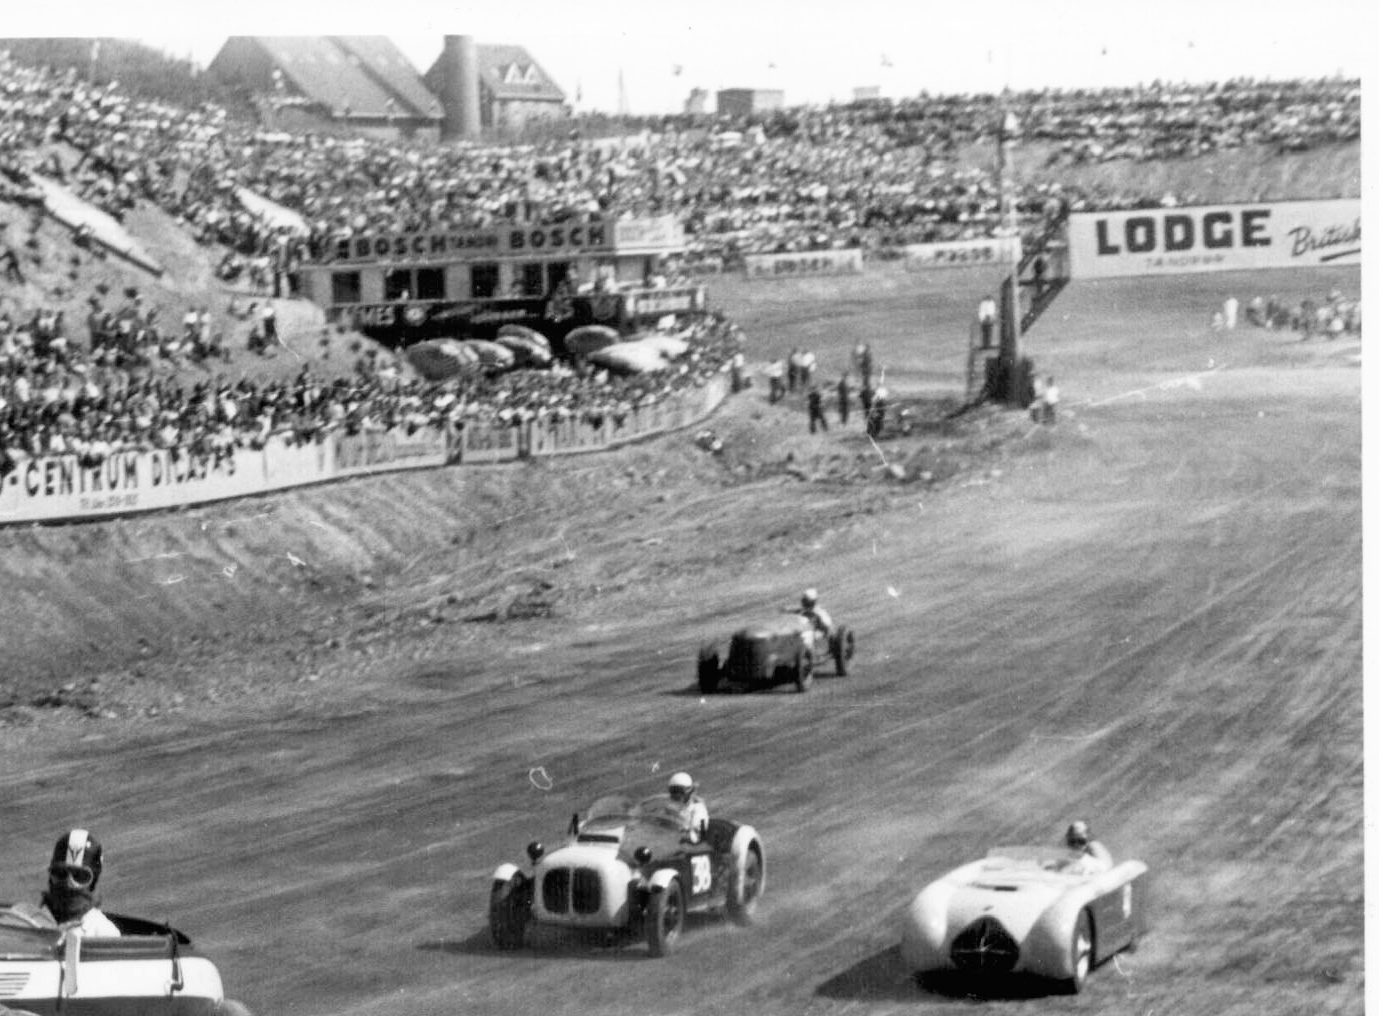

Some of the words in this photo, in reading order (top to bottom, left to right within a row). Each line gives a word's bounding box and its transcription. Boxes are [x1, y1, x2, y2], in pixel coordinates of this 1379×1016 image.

[356, 235, 447, 257] BOSCH
[510, 225, 605, 249] BOSCH
[1096, 209, 1272, 256] LODGE
